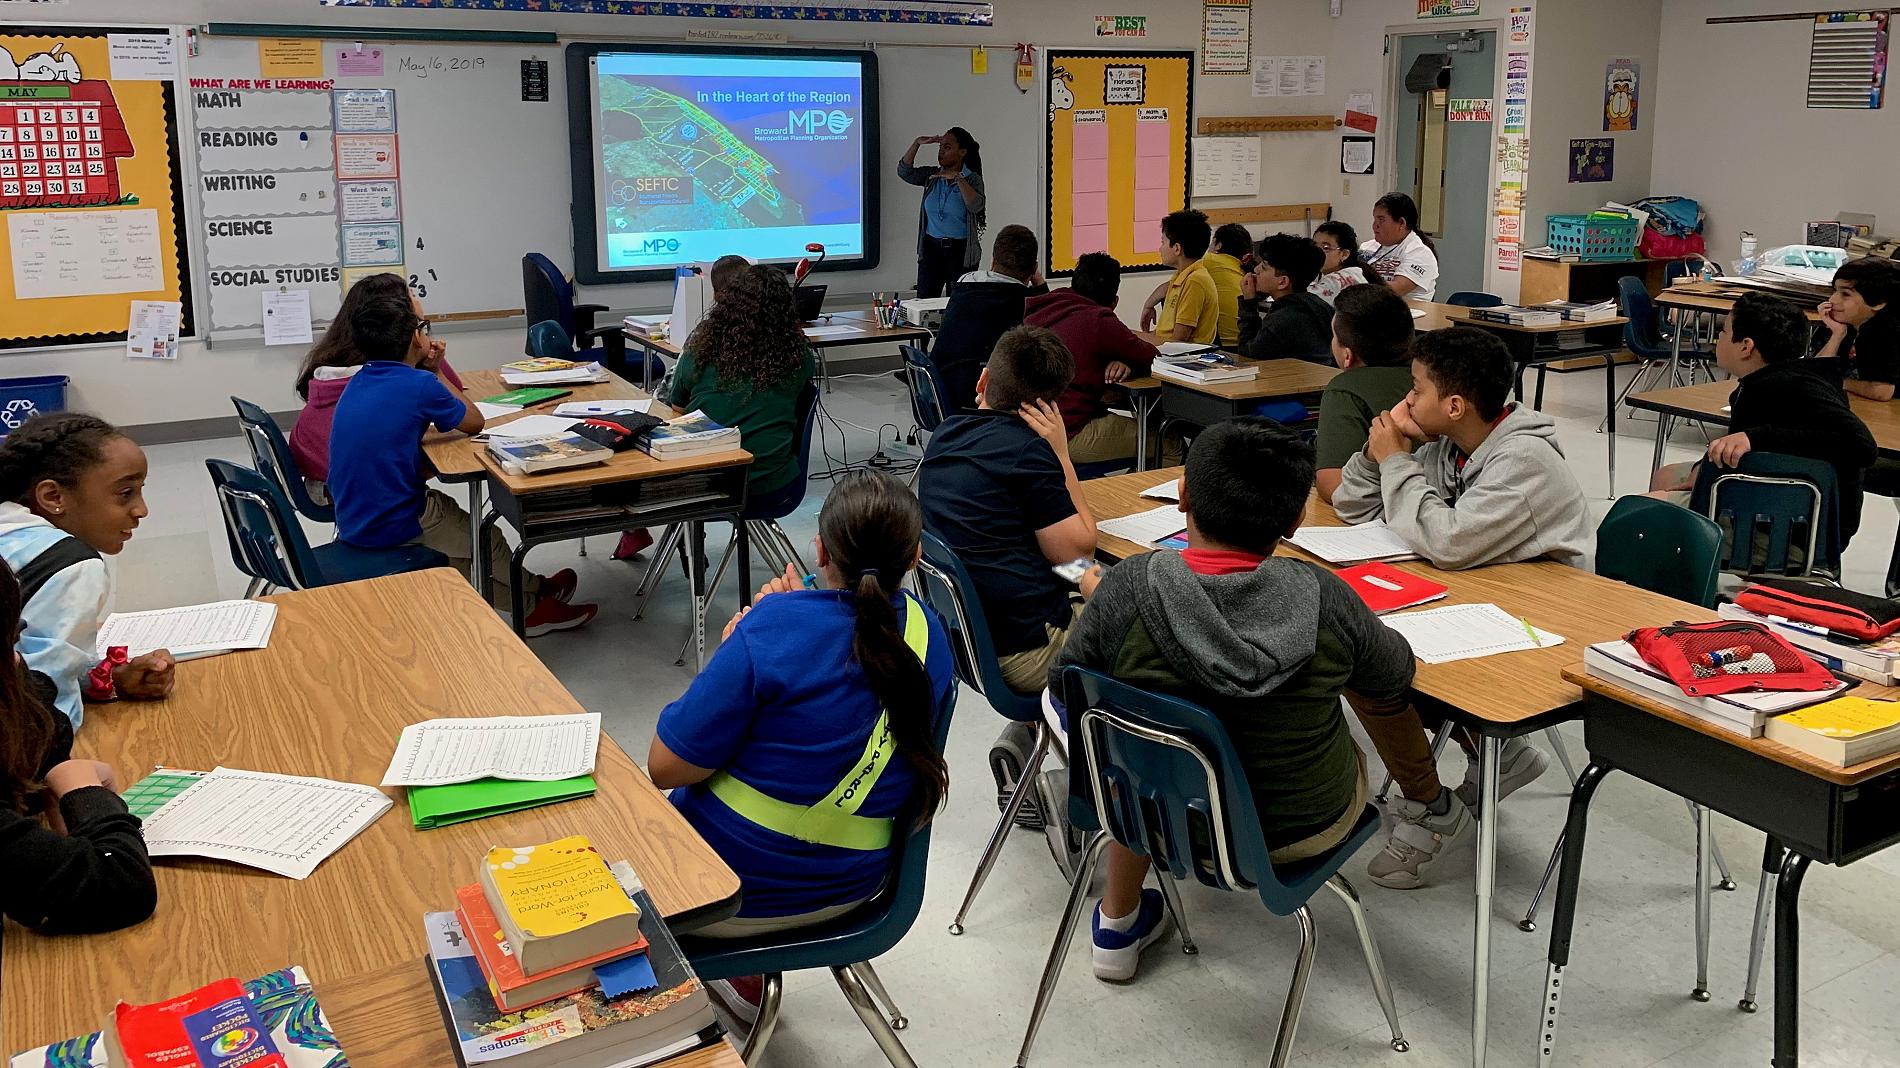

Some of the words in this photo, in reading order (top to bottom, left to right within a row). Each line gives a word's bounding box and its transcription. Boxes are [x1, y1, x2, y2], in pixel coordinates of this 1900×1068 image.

[1431, 5, 1451, 16] Wise
[1114, 16, 1146, 30] BEST
[1511, 16, 1530, 26] How
[399, 56, 428, 78] May
[450, 57, 485, 70] 2019
[190, 78, 224, 88] WHAT
[228, 79, 250, 88] ARE
[254, 80, 271, 89] WE
[275, 79, 334, 90] LEARNING?
[8, 88, 38, 97] MAY
[697, 91, 708, 102] In
[712, 91, 732, 102] the
[736, 92, 770, 102] Heart
[772, 92, 784, 102] of
[788, 92, 806, 102] the
[810, 92, 851, 104] Region
[198, 92, 242, 108] MATH
[1450, 100, 1472, 112] WALK
[24, 112, 28, 122] 1
[44, 112, 52, 121] 2
[66, 112, 73, 121] 3
[87, 111, 94, 120] 4
[788, 110, 851, 135] MPO
[1450, 112, 1474, 121] DON'T
[1475, 112, 1491, 121] RUN
[0, 130, 7, 140] 7
[23, 130, 30, 140] 8
[46, 130, 53, 140] 9
[66, 130, 77, 139] 10
[89, 130, 98, 139] 11
[201, 132, 278, 147] READING
[1, 148, 13, 158] 14
[23, 148, 34, 157] 15
[45, 147, 56, 157] 16
[67, 148, 77, 156] 17
[88, 147, 100, 156] 18
[3, 166, 16, 175] 21
[24, 166, 38, 174] 22
[47, 165, 60, 174] 23
[68, 164, 81, 174] 24
[90, 164, 102, 173] 25
[4, 184, 19, 193] 28
[27, 184, 41, 193] 29
[49, 183, 62, 192] 30
[72, 183, 83, 192] 31
[204, 175, 276, 191] WRITING
[636, 178, 679, 191] SEFTC
[208, 220, 273, 236] SCIENCE
[416, 237, 424, 250] 4
[644, 238, 680, 252] MPO
[1498, 248, 1517, 256] Parent
[210, 270, 269, 286] SOCIAL
[275, 267, 340, 284] STUDIES
[409, 274, 419, 288] 2
[428, 268, 437, 281] 1
[418, 285, 427, 298] 3
[834, 750, 880, 808] PATROL
[510, 868, 604, 896] DICTIONARY
[212, 1013, 248, 1032] POCKET
[524, 1020, 558, 1034] FLORIDA
[200, 1018, 250, 1042] DICCIONARIO
[480, 1024, 566, 1053] STEMscopes
[145, 1046, 189, 1058] ESPAÑOL
[156, 1050, 191, 1062] INGLÉS
[218, 1045, 265, 1068] DICTIONARY
[230, 1050, 267, 1068] POCKET
